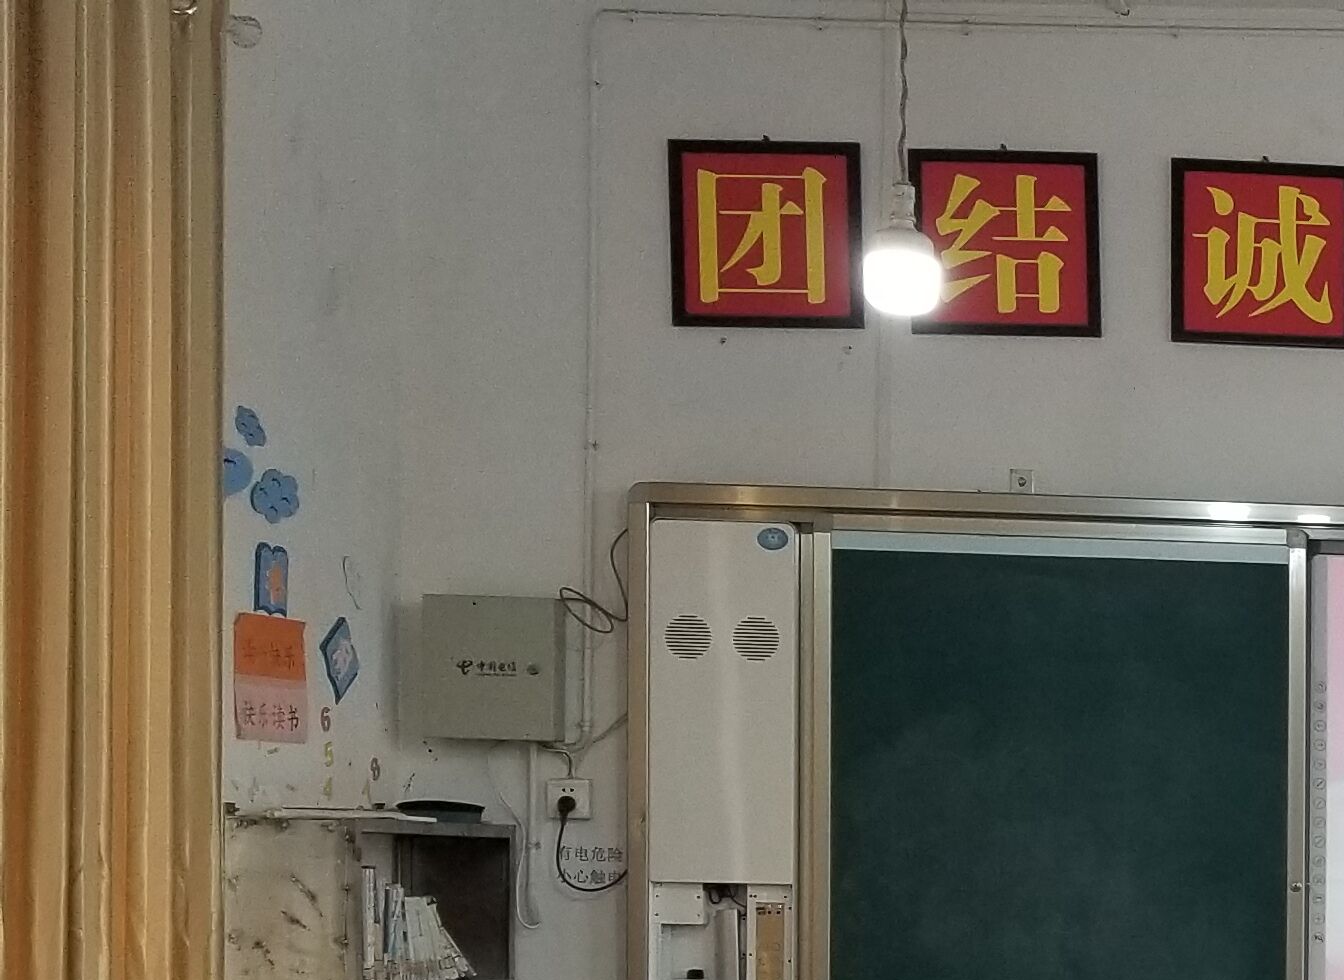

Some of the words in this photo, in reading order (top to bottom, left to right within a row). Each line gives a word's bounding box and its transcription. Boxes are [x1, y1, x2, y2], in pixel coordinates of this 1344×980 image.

[696, 167, 828, 306] 团
[935, 173, 1073, 315] 结
[1191, 184, 1336, 326] 诚
[320, 706, 332, 733] 6
[557, 868, 623, 885] 小心触电
[559, 845, 624, 863] 有电危险
